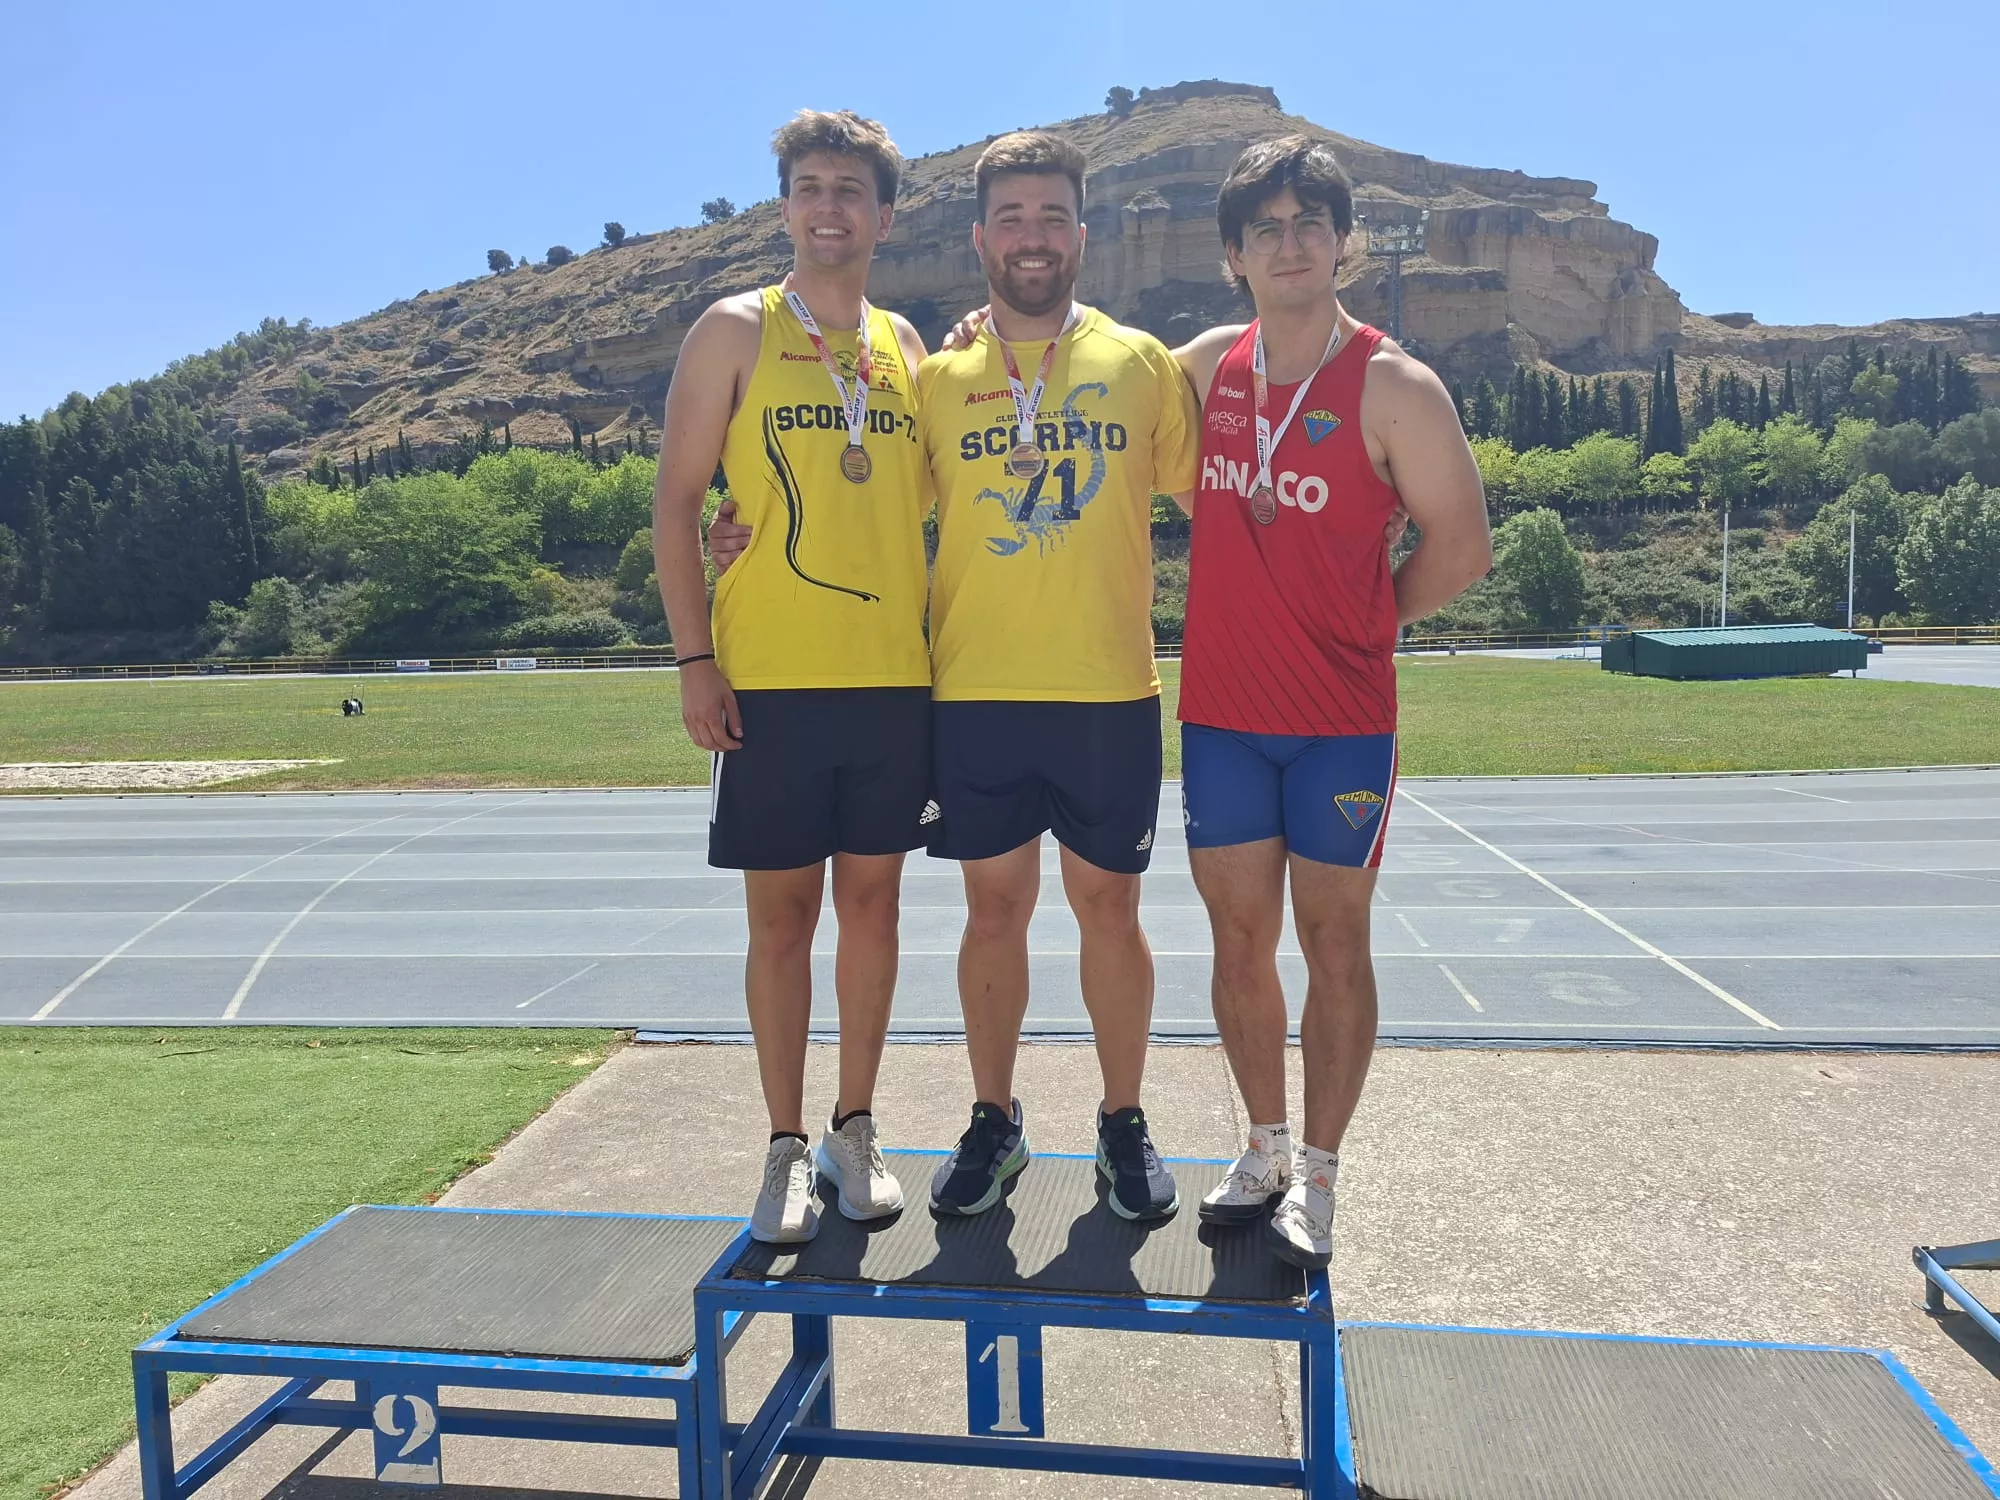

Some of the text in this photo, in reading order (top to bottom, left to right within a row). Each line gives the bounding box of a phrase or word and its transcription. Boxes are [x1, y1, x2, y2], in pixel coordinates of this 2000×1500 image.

[780, 351, 823, 363] Alcamp
[965, 388, 1027, 406] Alcam
[1004, 457, 1080, 522] 71
[979, 1335, 1030, 1432] 1
[373, 1394, 440, 1484] 2
